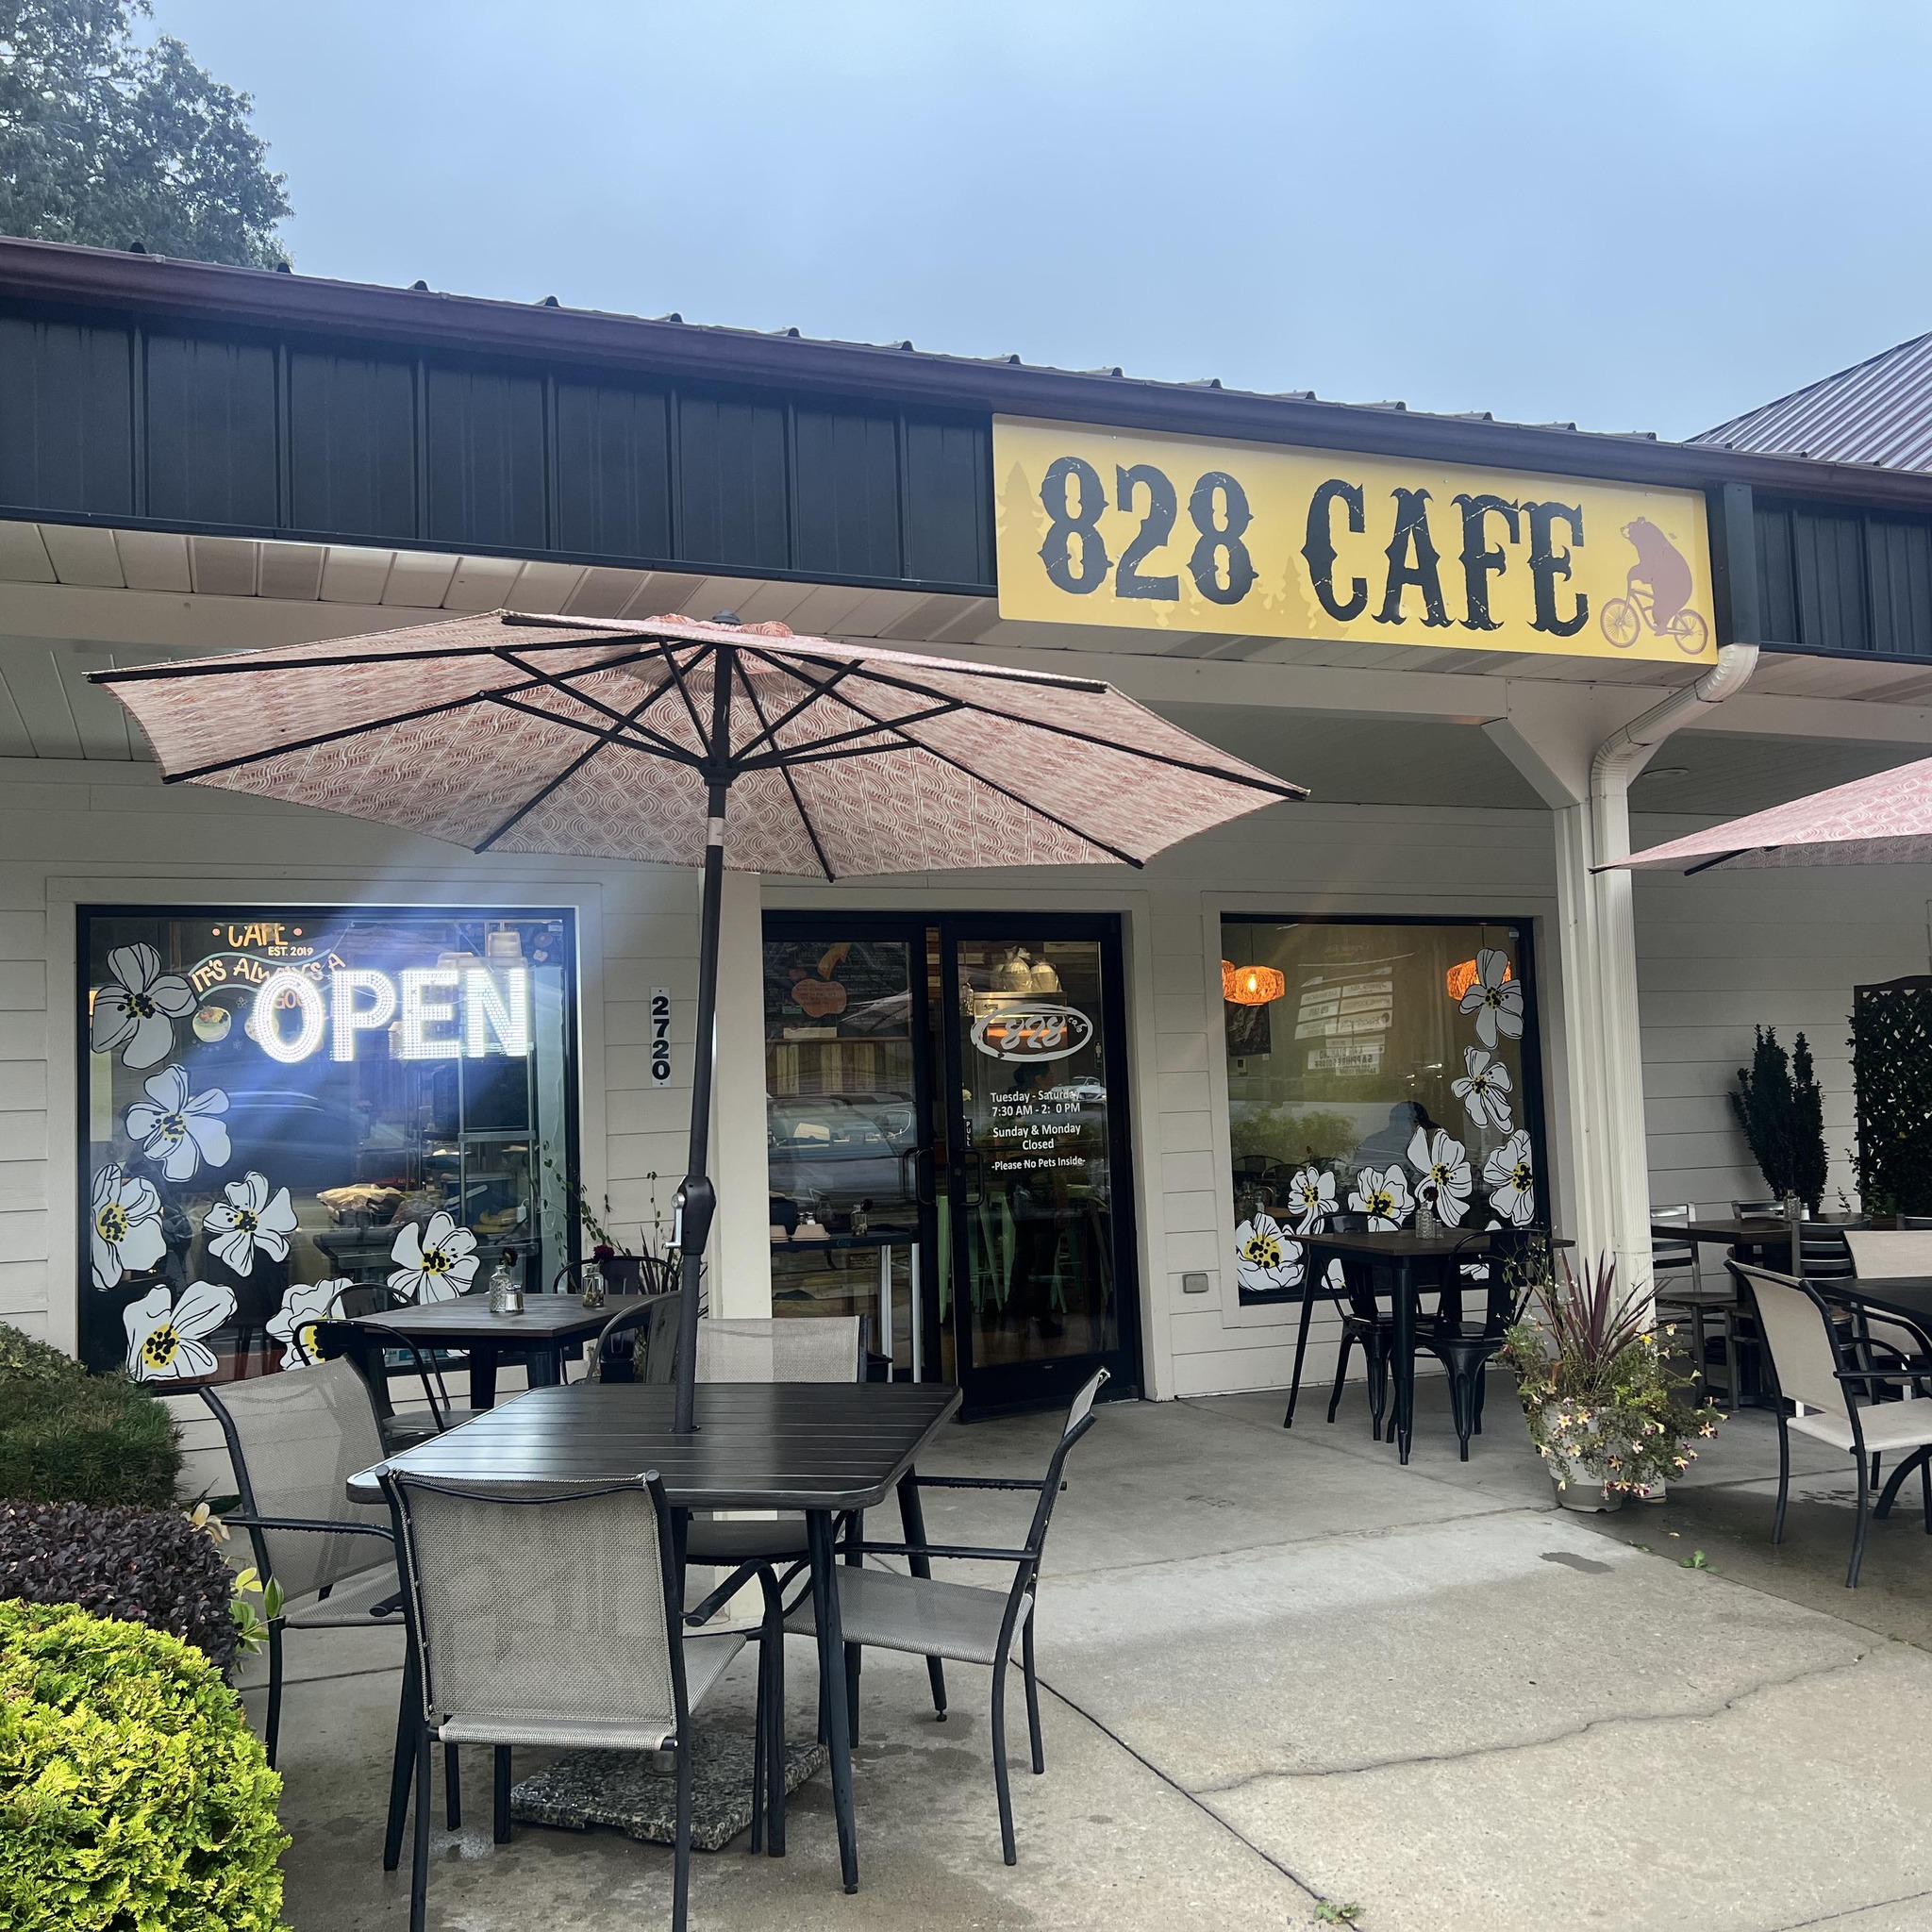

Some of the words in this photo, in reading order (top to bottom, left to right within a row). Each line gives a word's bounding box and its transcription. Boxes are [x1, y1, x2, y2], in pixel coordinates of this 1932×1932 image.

[1038, 456, 1259, 606] 828
[1299, 478, 1590, 637] CAFE
[268, 946, 289, 957] EST.
[290, 946, 314, 957] 2019
[192, 959, 227, 992] IT'S
[232, 958, 325, 984] ALWYS
[328, 953, 346, 973] A
[252, 967, 530, 1063] OPEN
[652, 996, 671, 1080] 2720
[1000, 1014, 1065, 1050] 828
[990, 1091, 1030, 1103] Tuesday
[1038, 1090, 1080, 1102] Saturday
[992, 1106, 1013, 1117] 7:30
[1015, 1105, 1033, 1116] AM
[1064, 1103, 1080, 1113] PM
[992, 1126, 1028, 1138] Sunday
[1031, 1124, 1040, 1135] &
[1041, 1123, 1081, 1135] Monday
[1022, 1138, 1055, 1150] Closed
[1024, 1158, 1037, 1169] No
[1038, 1158, 1056, 1168] Pets
